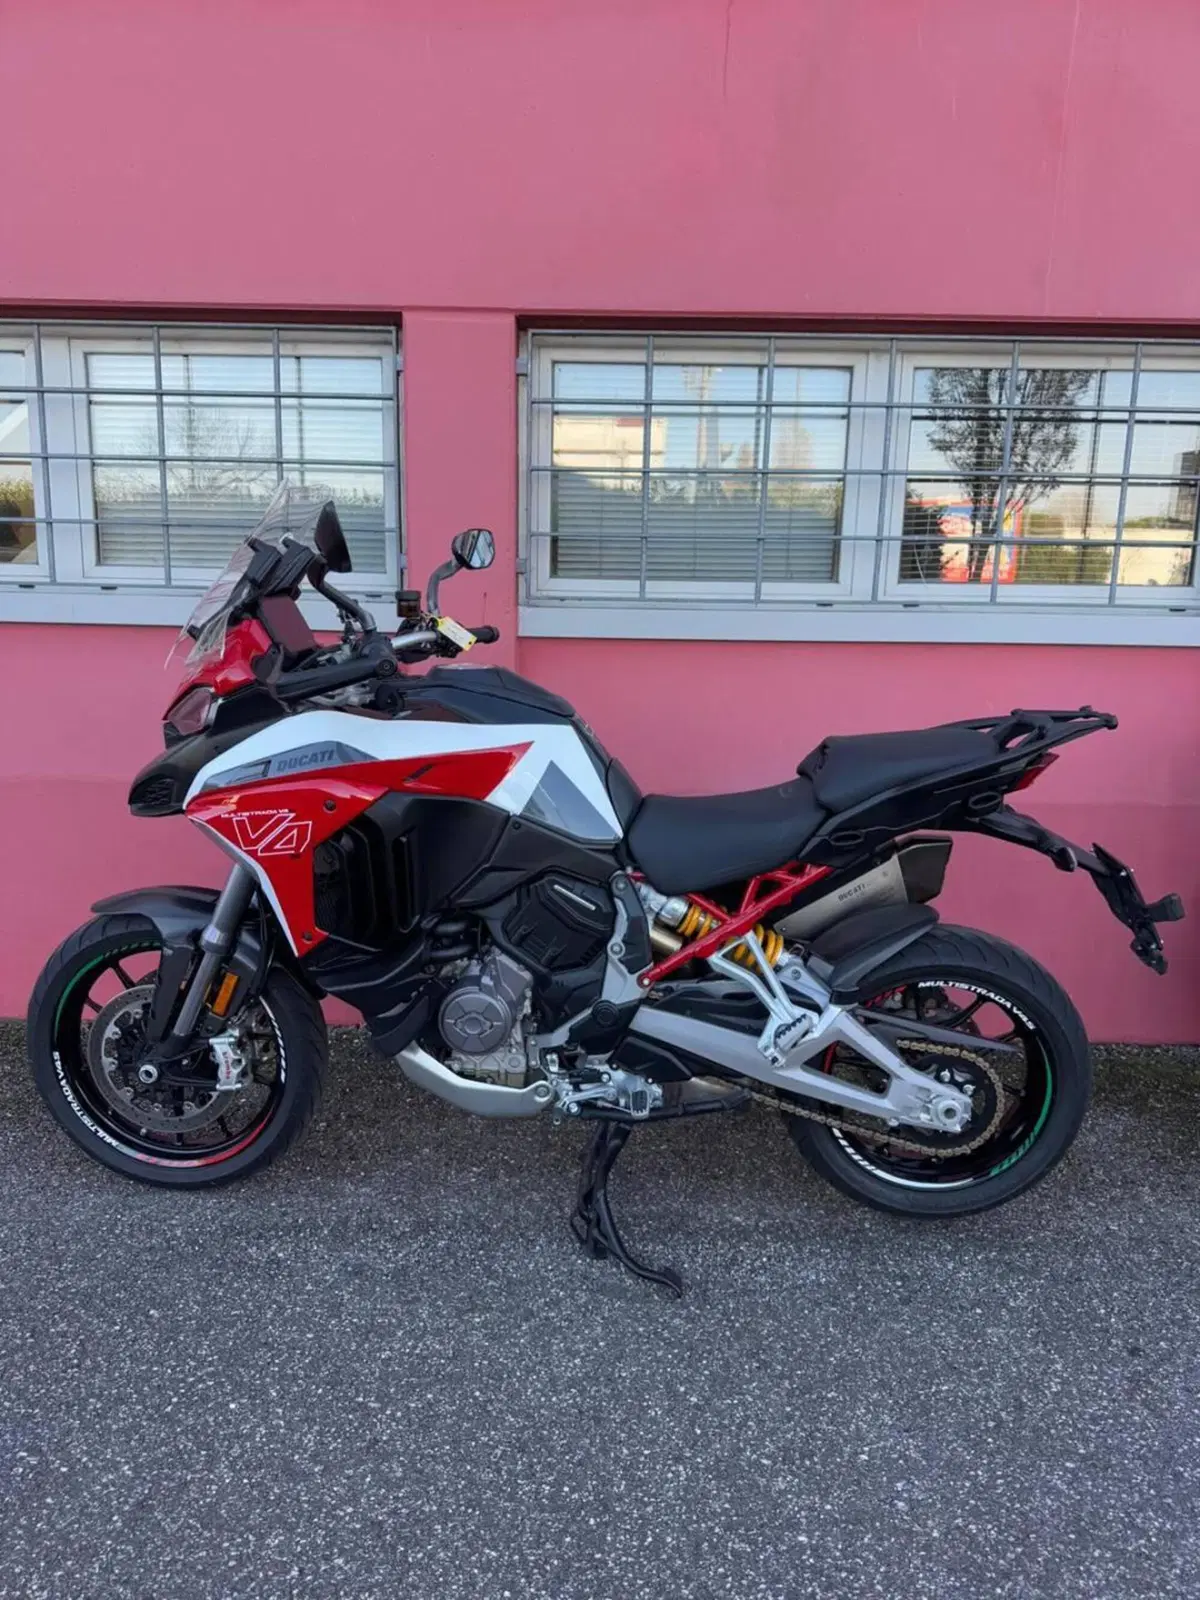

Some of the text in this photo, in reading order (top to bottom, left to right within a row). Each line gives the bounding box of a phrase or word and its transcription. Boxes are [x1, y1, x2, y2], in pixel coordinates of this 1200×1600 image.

[276, 750, 335, 772] DUCATI
[232, 813, 313, 856] V4
[838, 883, 865, 901] DUCATI
[918, 981, 1012, 1009] MULTISTRADA
[60, 1079, 119, 1147] MULTISTRADA
